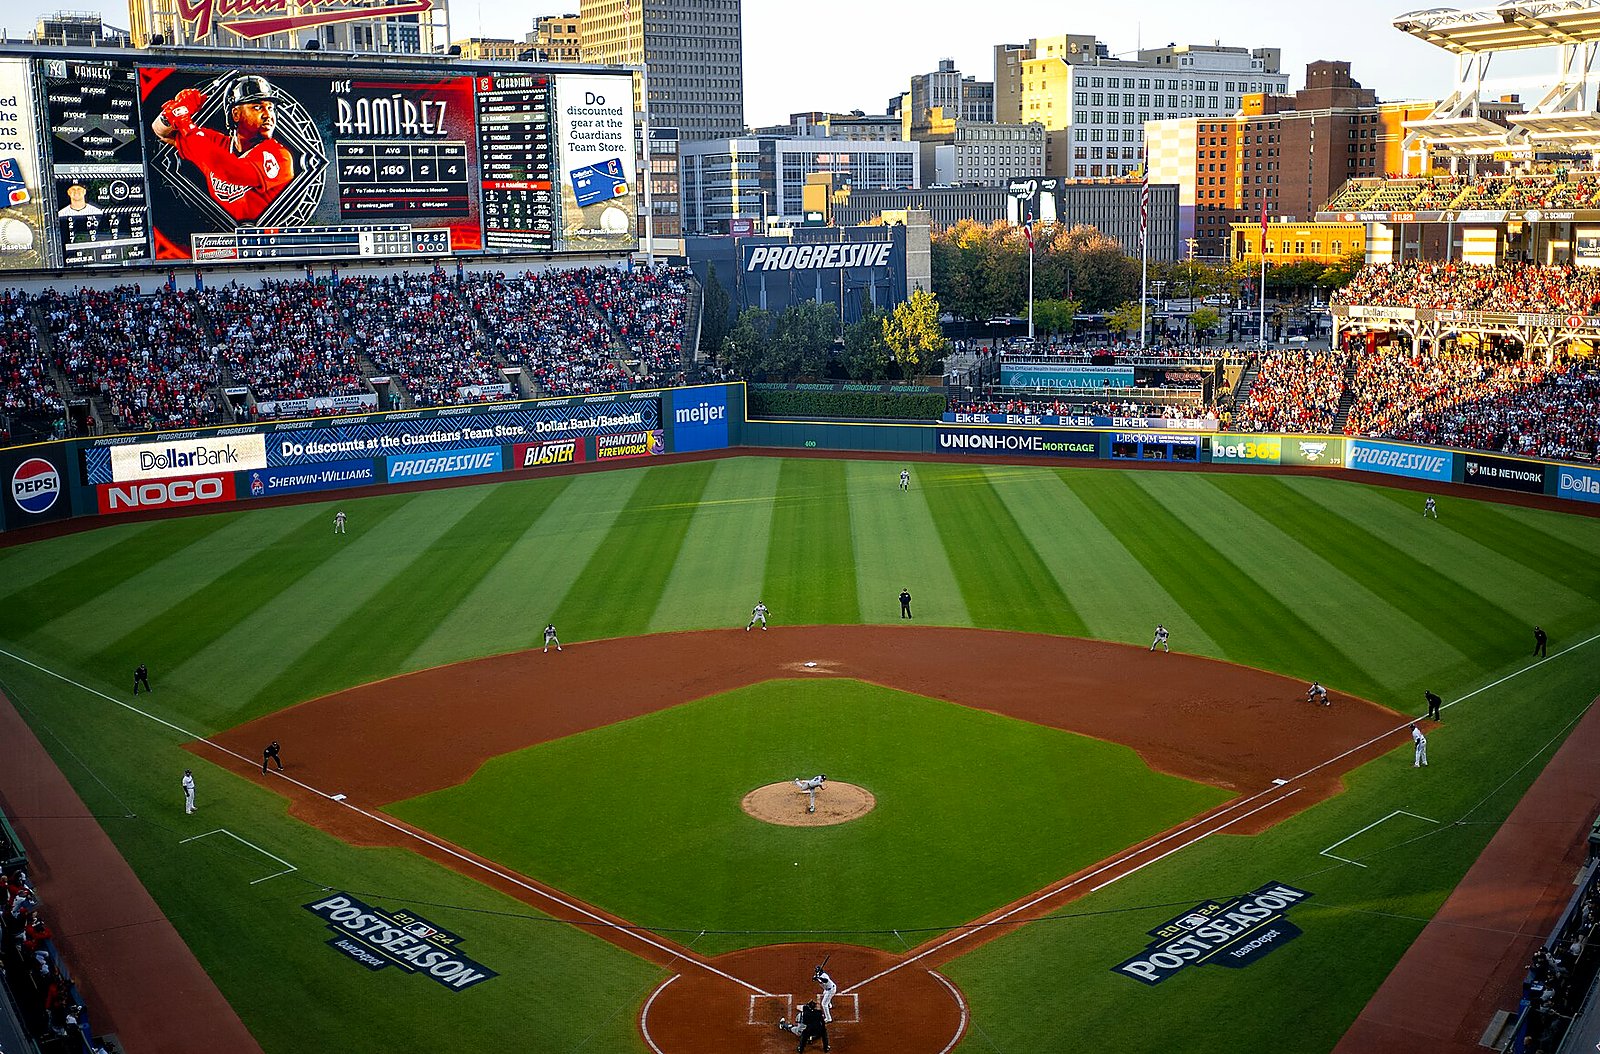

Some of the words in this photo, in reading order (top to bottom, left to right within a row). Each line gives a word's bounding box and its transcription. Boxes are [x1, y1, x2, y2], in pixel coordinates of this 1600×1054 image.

[74, 66, 111, 80] YANKEES
[496, 77, 533, 88] GUARDIANS
[0, 96, 17, 107] ed
[57, 96, 82, 104] VERDUGO
[585, 91, 606, 106] Do
[334, 94, 448, 135] RAMÍREZ
[566, 105, 623, 116] discounted
[570, 120, 594, 130] gear
[594, 119, 605, 128] at
[606, 118, 623, 128] the
[569, 130, 622, 140] Guardians
[567, 142, 597, 152] Team
[598, 142, 627, 152] Store.
[343, 165, 371, 175] .740
[380, 165, 405, 175] .160
[420, 165, 430, 175] 2
[447, 165, 457, 175] 4
[69, 236, 75, 244] 7
[199, 237, 234, 250] Yankees
[423, 234, 429, 243] 2
[257, 249, 263, 257] 0
[747, 242, 894, 271] PROGRESSIVE
[1362, 307, 1400, 318] DollarBank
[796, 383, 834, 391] PROGRESSIVE
[842, 384, 882, 392] PROGRESSIVE
[890, 385, 930, 393] PROGRESSIVE
[1030, 377, 1077, 388] MEDICAL
[1081, 378, 1127, 389] MUUAL
[584, 395, 616, 403] PROGRESSIVE
[629, 391, 661, 400] PROGRESSIVE
[488, 403, 522, 411] PROGRESSIVE
[537, 399, 570, 407] PROGRESSIVE
[385, 411, 422, 421] PROGRESSIVE
[437, 407, 472, 416] PROGRESSIVE
[676, 402, 725, 425] meijer
[275, 421, 314, 431] PROGRESSIVE
[331, 416, 369, 425] PROGRESSIVE
[536, 412, 642, 433] Dollar.Bank/Baseball
[156, 431, 198, 441] PROGRESSIVE
[217, 426, 256, 435] PROGRESSIVE
[94, 436, 137, 446] PROGRESSIVE
[282, 441, 303, 457] Do
[306, 438, 365, 455] discounts
[366, 438, 379, 449] at
[380, 434, 401, 448] the
[402, 430, 461, 445] Guardians
[462, 427, 494, 440] Team
[495, 424, 527, 438] Store.
[599, 431, 647, 447] PHANTOM
[598, 444, 647, 458] FIREWORKS
[1042, 443, 1095, 453] MORTGAGE
[1213, 441, 1280, 460] bet365
[140, 444, 237, 471] DollarBank
[523, 443, 576, 466] BLASTER
[1350, 445, 1446, 474] PROGRESSIVE
[390, 451, 496, 478] PROGRESSIVE
[1479, 465, 1497, 477] MLB
[1498, 468, 1542, 483] NETWORK
[15, 475, 58, 495] PEPSI
[1560, 473, 1600, 494] Dolla
[108, 479, 224, 509] NOCO
[1156, 925, 1181, 938] 20
[1198, 903, 1221, 916] 24
[393, 912, 415, 925] 20
[431, 933, 456, 945] 24
[1121, 886, 1305, 982] POSTSEASON
[311, 895, 485, 988] POSTSEASON
[1229, 928, 1281, 958] loanDepot
[334, 938, 386, 967] loanDepot
